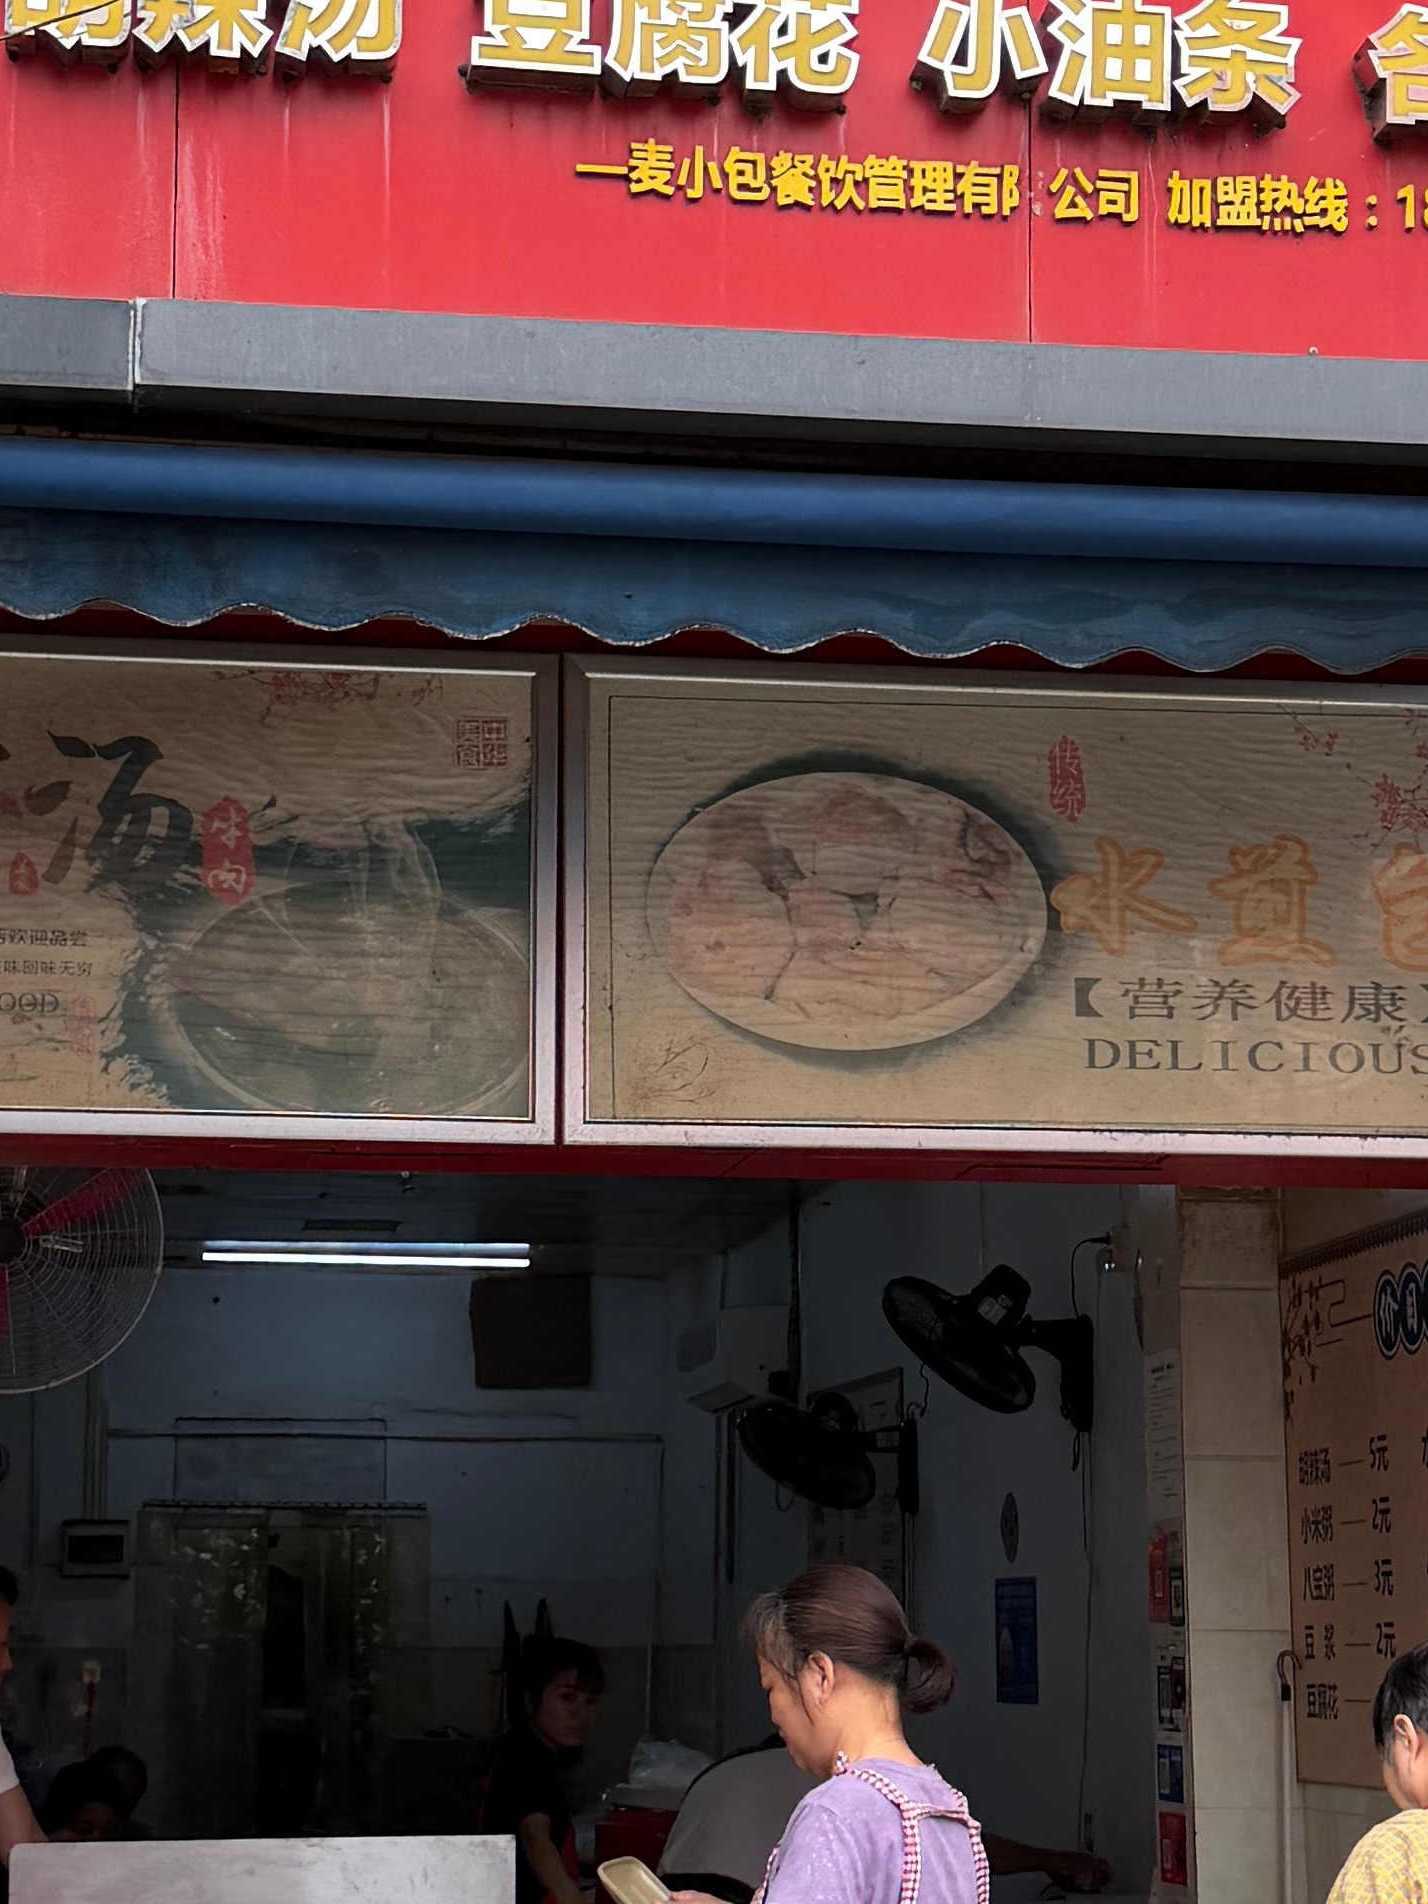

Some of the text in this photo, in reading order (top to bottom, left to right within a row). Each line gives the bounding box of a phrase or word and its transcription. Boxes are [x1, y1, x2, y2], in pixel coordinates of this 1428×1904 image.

[1052, 739, 1082, 817] 传统
[208, 805, 248, 895] 牛肉
[1299, 1434, 1389, 1486] 胡辣汤 5元
[1301, 1496, 1391, 1544] 小米粥 2元
[1303, 1559, 1393, 1602] 八宝粥 3元
[1304, 1622, 1396, 1660] 豆浆 2元
[1306, 1682, 1338, 1720] 豆腐花
